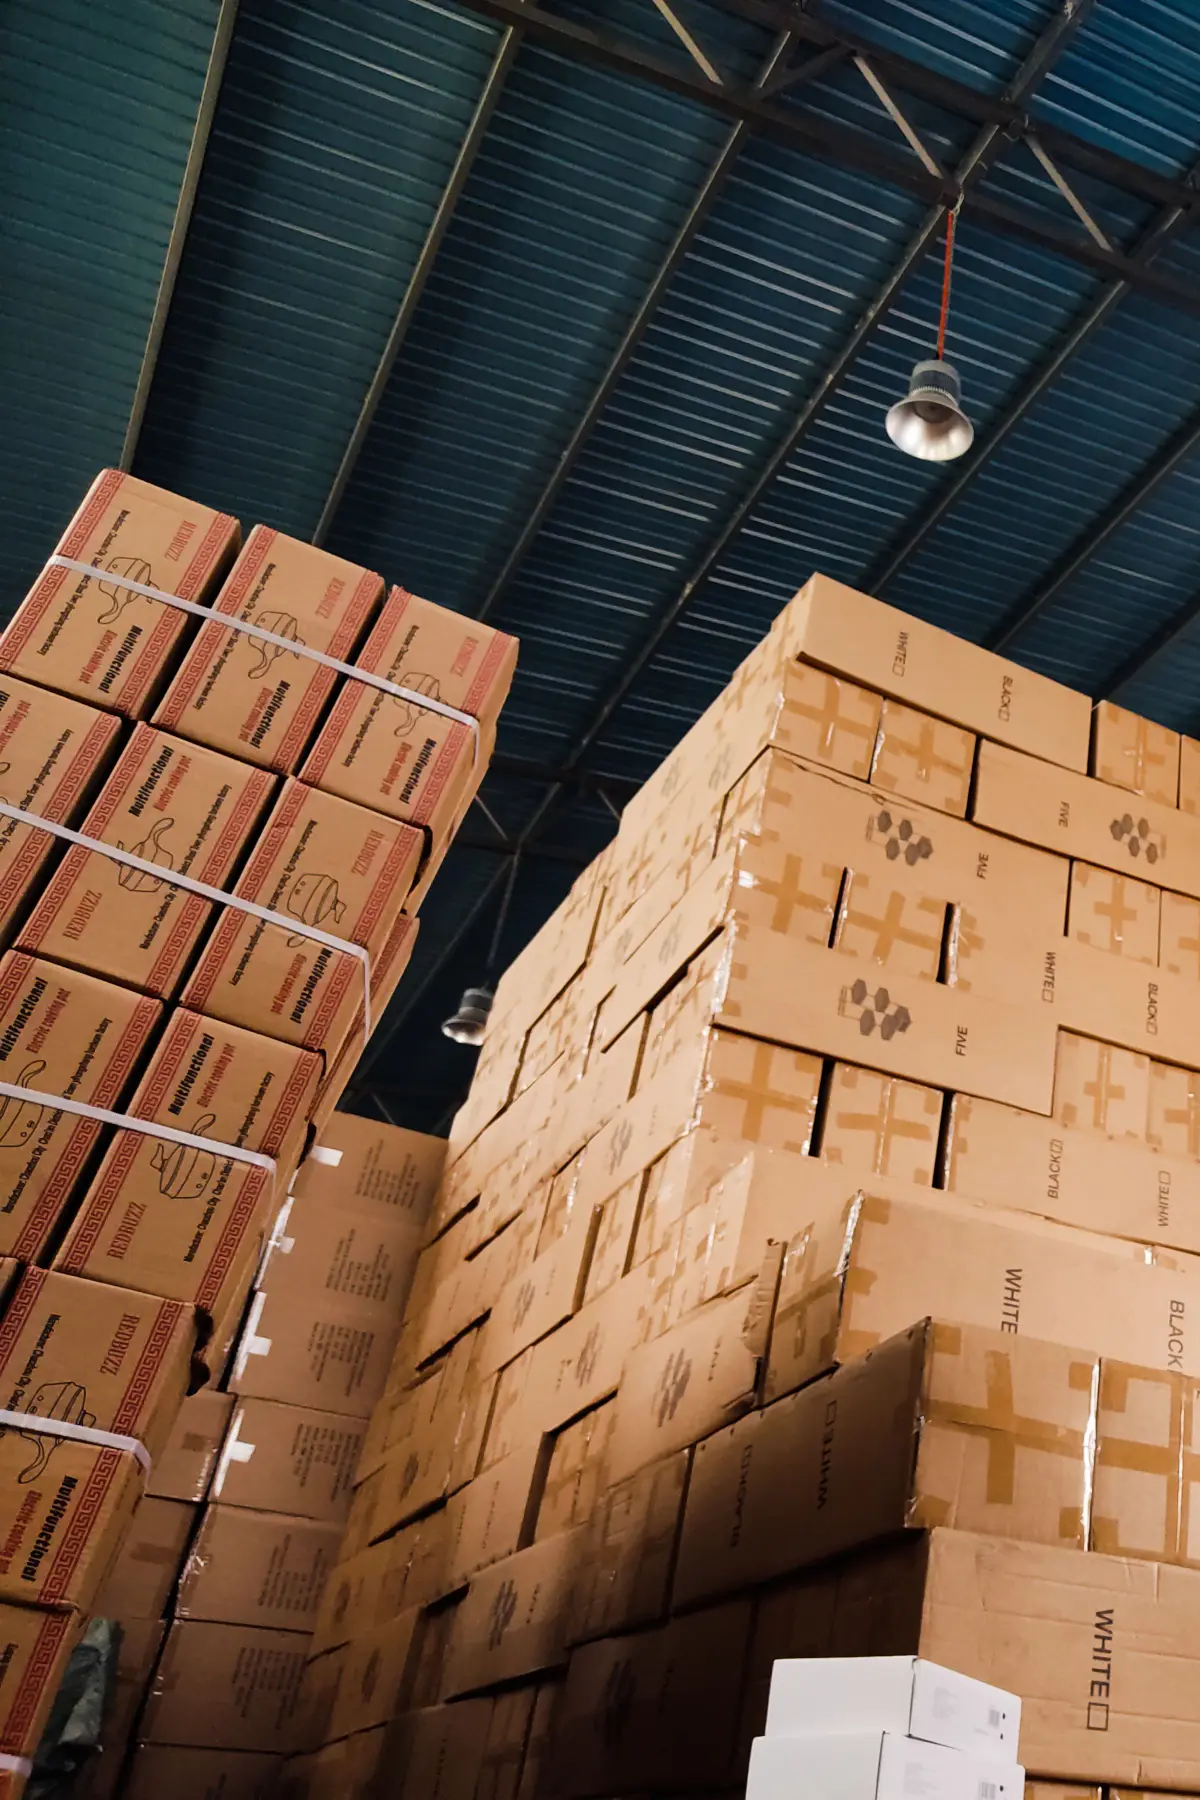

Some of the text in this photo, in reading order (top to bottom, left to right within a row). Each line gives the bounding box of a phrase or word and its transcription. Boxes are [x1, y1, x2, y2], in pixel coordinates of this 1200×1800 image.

[164, 520, 196, 561] REDBUZZ
[99, 626, 142, 693] Multifunctional
[896, 632, 908, 665] WHITE
[250, 680, 290, 748] Multifunctional
[1000, 675, 1013, 709] BLACK
[129, 746, 173, 816] Multifunctional
[399, 738, 436, 804] Multifunctional
[1058, 801, 1070, 828] FIVE
[351, 830, 384, 876] REDBUZZ
[976, 853, 989, 879] FIVE
[63, 890, 102, 940] REDBUZZ
[290, 948, 332, 1023] Multifunctional
[1044, 951, 1056, 989] WHITE
[25, 1026, 50, 1054] Electric
[56, 988, 71, 1002] pot
[1147, 982, 1158, 1020] BLACK
[956, 1026, 968, 1056] FIVE
[168, 1034, 214, 1115] Multifunctional
[197, 1043, 234, 1108] Electric cooking pot
[1047, 1154, 1061, 1199] BLACK
[107, 1202, 146, 1259] REDBUZZ
[1158, 1186, 1169, 1227] WHITE
[1001, 1268, 1023, 1334] WHITE
[100, 1314, 140, 1375] REDBUZZ
[1168, 1300, 1185, 1368] BLACK
[817, 1428, 834, 1510] WHITE
[16, 1490, 42, 1524] Electric
[22, 1476, 77, 1581] Multifunctional
[1090, 1609, 1114, 1698] WHITE
